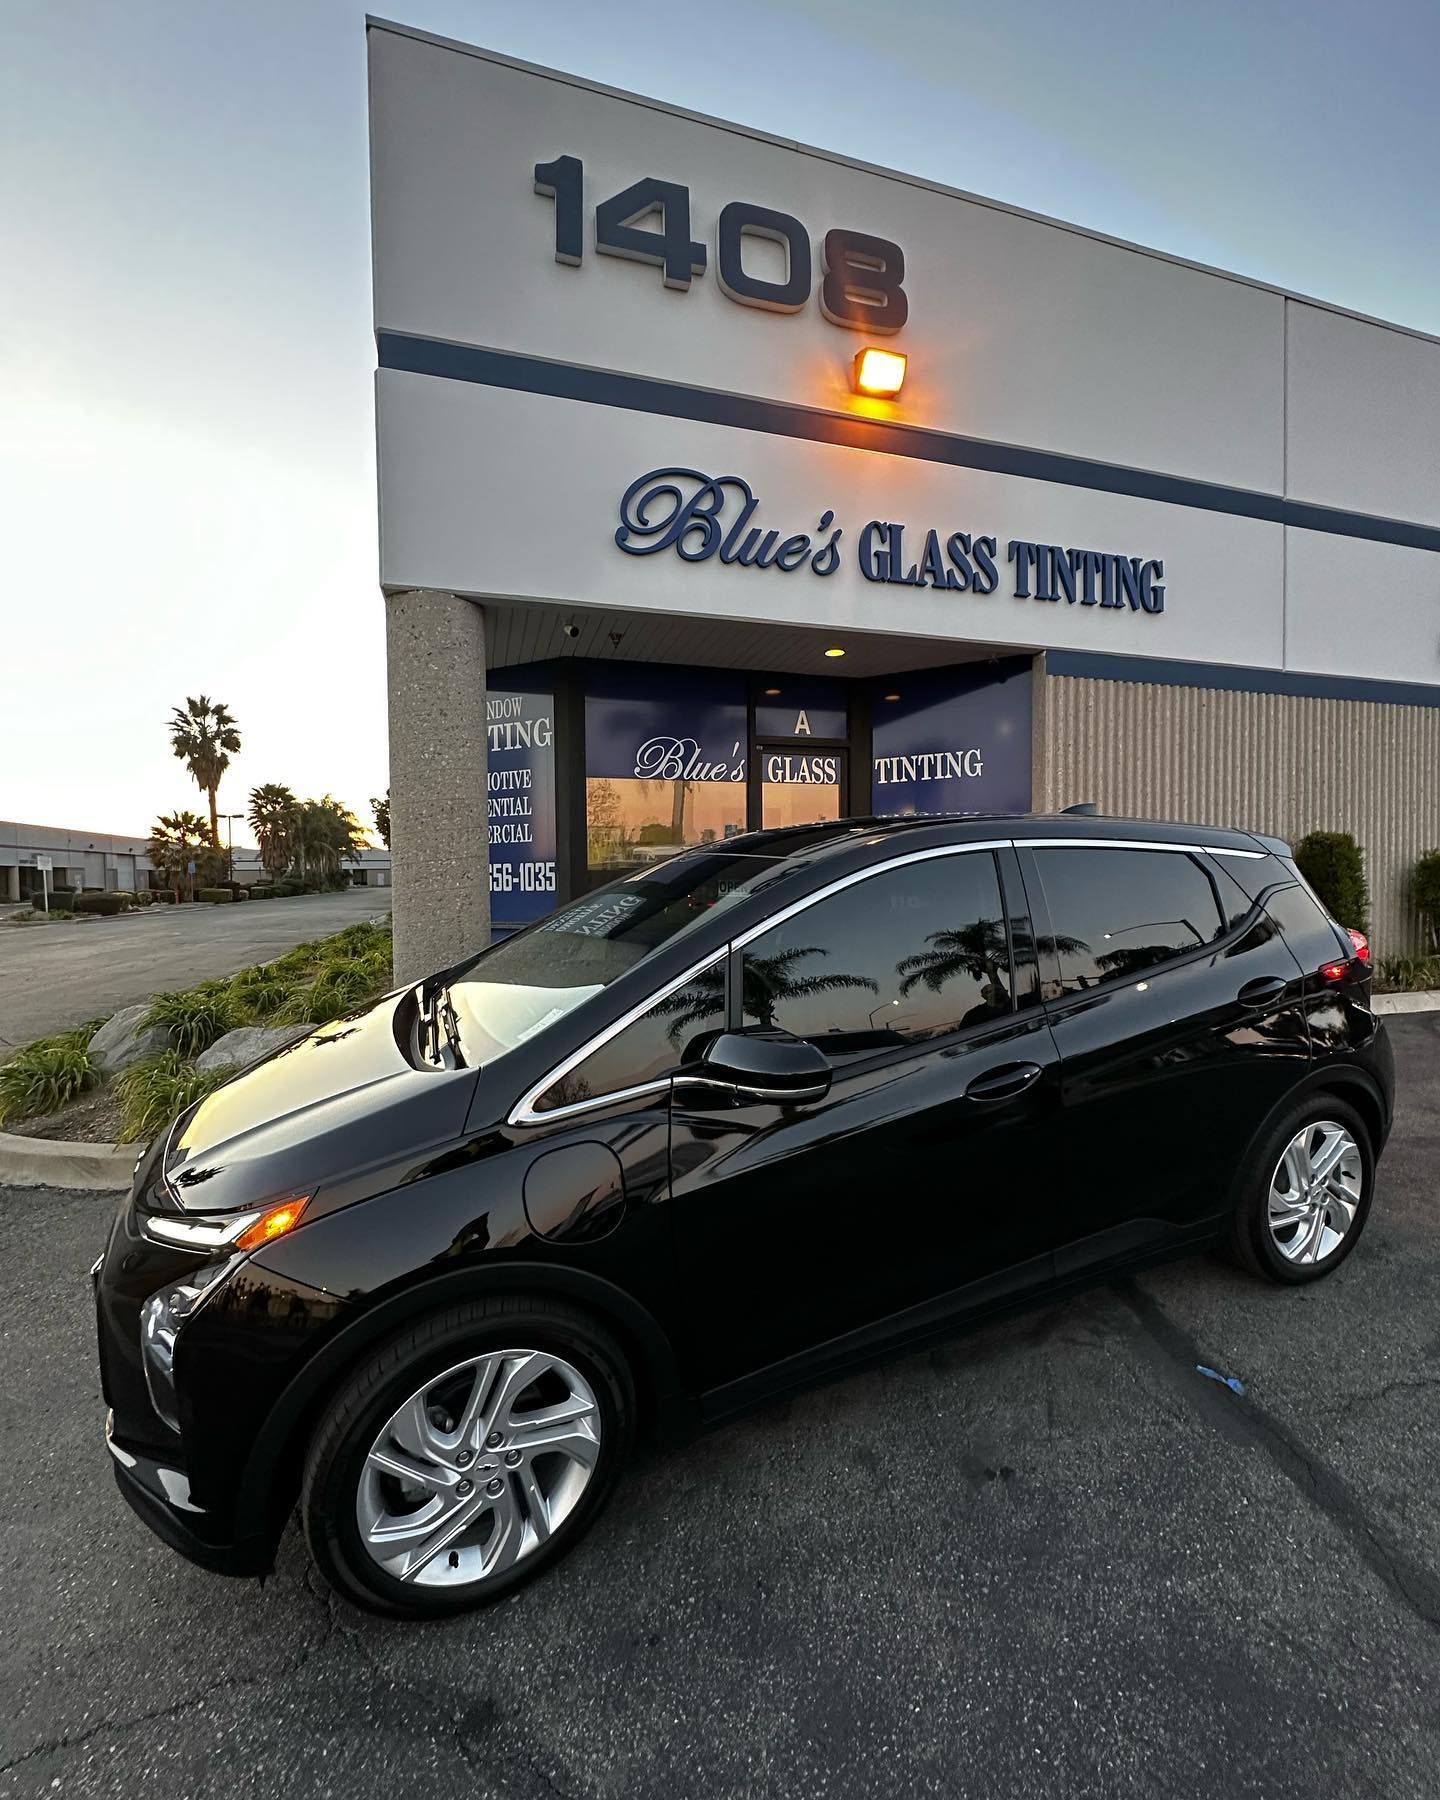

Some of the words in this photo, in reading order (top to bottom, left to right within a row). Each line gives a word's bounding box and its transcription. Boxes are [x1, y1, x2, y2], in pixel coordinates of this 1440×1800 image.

[534, 155, 908, 334] 1408
[615, 467, 842, 576] Blue's
[858, 521, 998, 594] GLASS
[1007, 541, 1165, 614] TINTING
[488, 717, 553, 752] TING
[794, 710, 811, 735] A
[634, 736, 745, 782] Blue's
[767, 756, 837, 784] GLASS
[874, 748, 983, 784] TINTING
